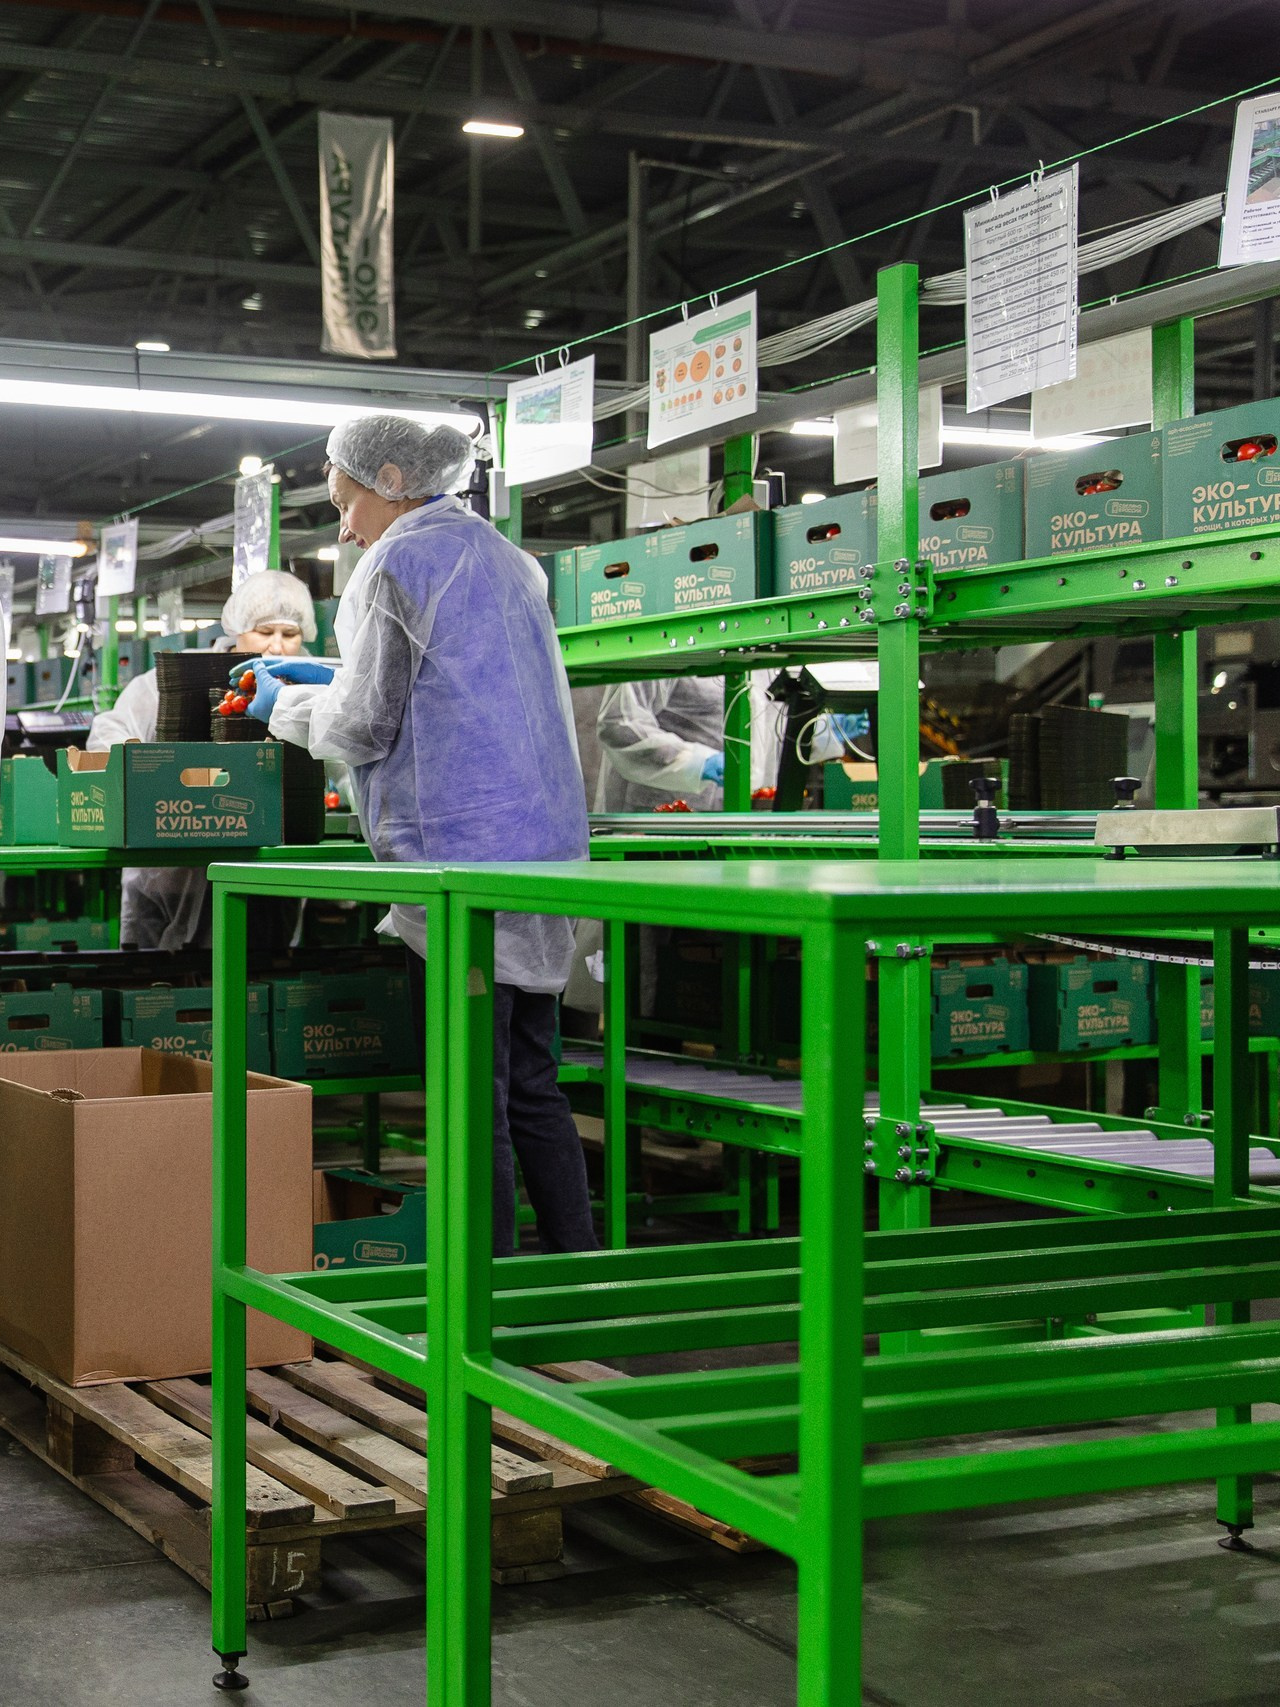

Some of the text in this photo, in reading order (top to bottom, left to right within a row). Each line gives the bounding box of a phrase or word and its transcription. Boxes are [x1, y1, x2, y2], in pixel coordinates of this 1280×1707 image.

[974, 208, 1014, 227] Минимальный
[1020, 188, 1063, 209] максимальный
[1002, 217, 1017, 226] весах
[1029, 203, 1052, 215] фасовке
[1192, 481, 1250, 503] ЭКО-
[1051, 511, 1099, 532] ЭКО-
[1194, 522, 1223, 533] овощи,
[1231, 516, 1267, 526] которых
[1051, 520, 1142, 549] КУЛЬТУРА
[919, 536, 951, 552] КО-
[921, 545, 988, 567] ЛЬТУРА
[790, 557, 825, 574] ЭКО-
[674, 574, 705, 590] ЭКО-
[790, 567, 856, 590] КУЛЬТУРА
[591, 589, 618, 604] ЭКО-
[674, 584, 732, 604] КУЛЬТУРА
[591, 599, 642, 618] КУЛЬТУРА
[71, 808, 104, 823] КУЛЬТУРА
[155, 800, 207, 815] ЭКО-
[156, 816, 248, 830] КУЛЬТУРА
[190, 831, 220, 839] которых
[222, 830, 248, 838] уверен
[303, 1024, 346, 1038] ЭКО-
[950, 1021, 1005, 1036] КУЛЬТУРА
[1078, 1015, 1129, 1030] КУЛЬТУРА
[151, 1036, 197, 1050] ЭКО-
[304, 1036, 382, 1053] КУЛЬТУРА
[271, 1548, 306, 1592] 15
